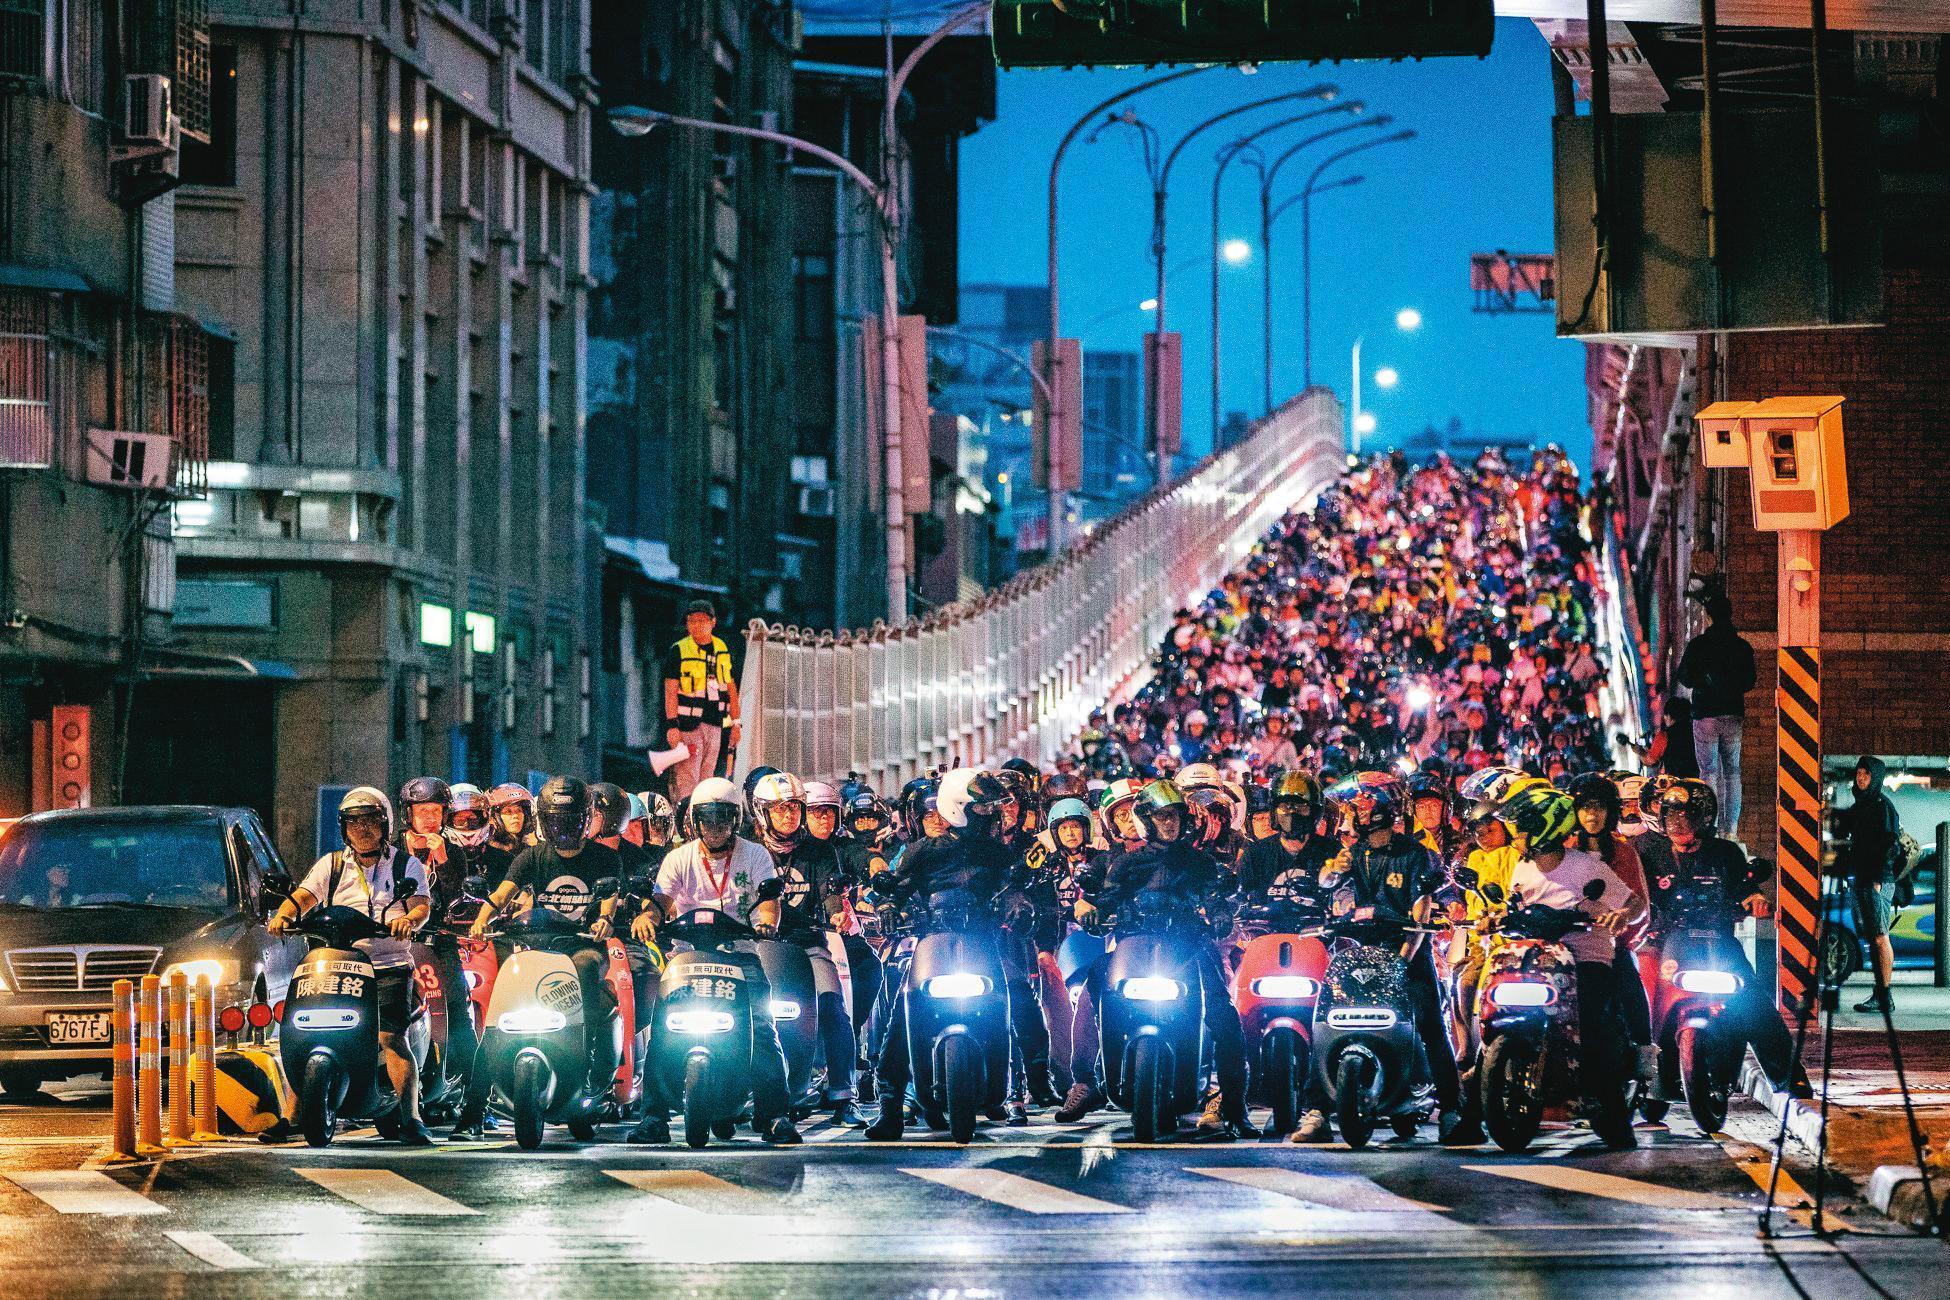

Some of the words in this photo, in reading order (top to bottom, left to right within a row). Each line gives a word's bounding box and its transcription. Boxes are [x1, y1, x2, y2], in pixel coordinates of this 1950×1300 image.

[296, 975, 365, 998] 陳建銘
[541, 980, 579, 1005] FLOWING
